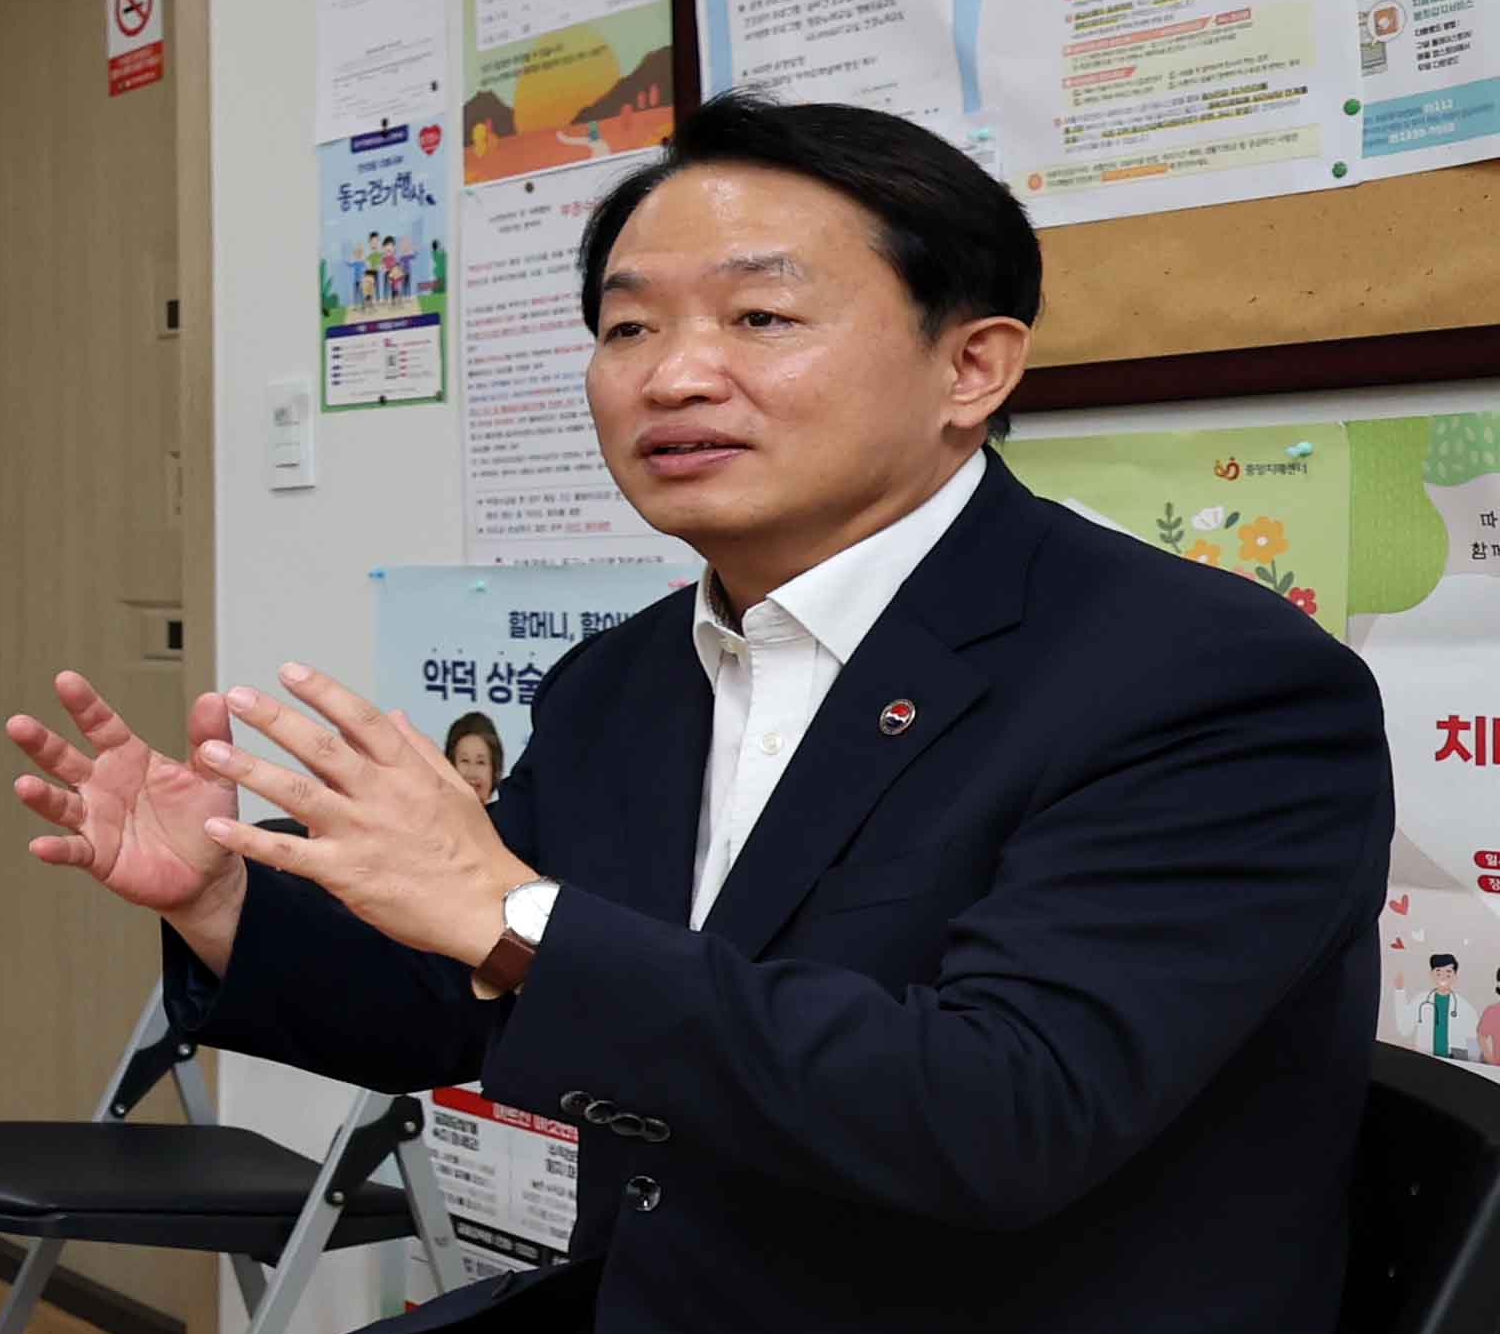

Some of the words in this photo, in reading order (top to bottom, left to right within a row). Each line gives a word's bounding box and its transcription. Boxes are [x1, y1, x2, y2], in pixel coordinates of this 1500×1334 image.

[1245, 462, 1308, 476] 중앙치매센터
[509, 611, 575, 642] 할머니,
[581, 611, 633, 639] 할아
[423, 659, 477, 702] 악덕
[1435, 715, 1500, 766] 치
